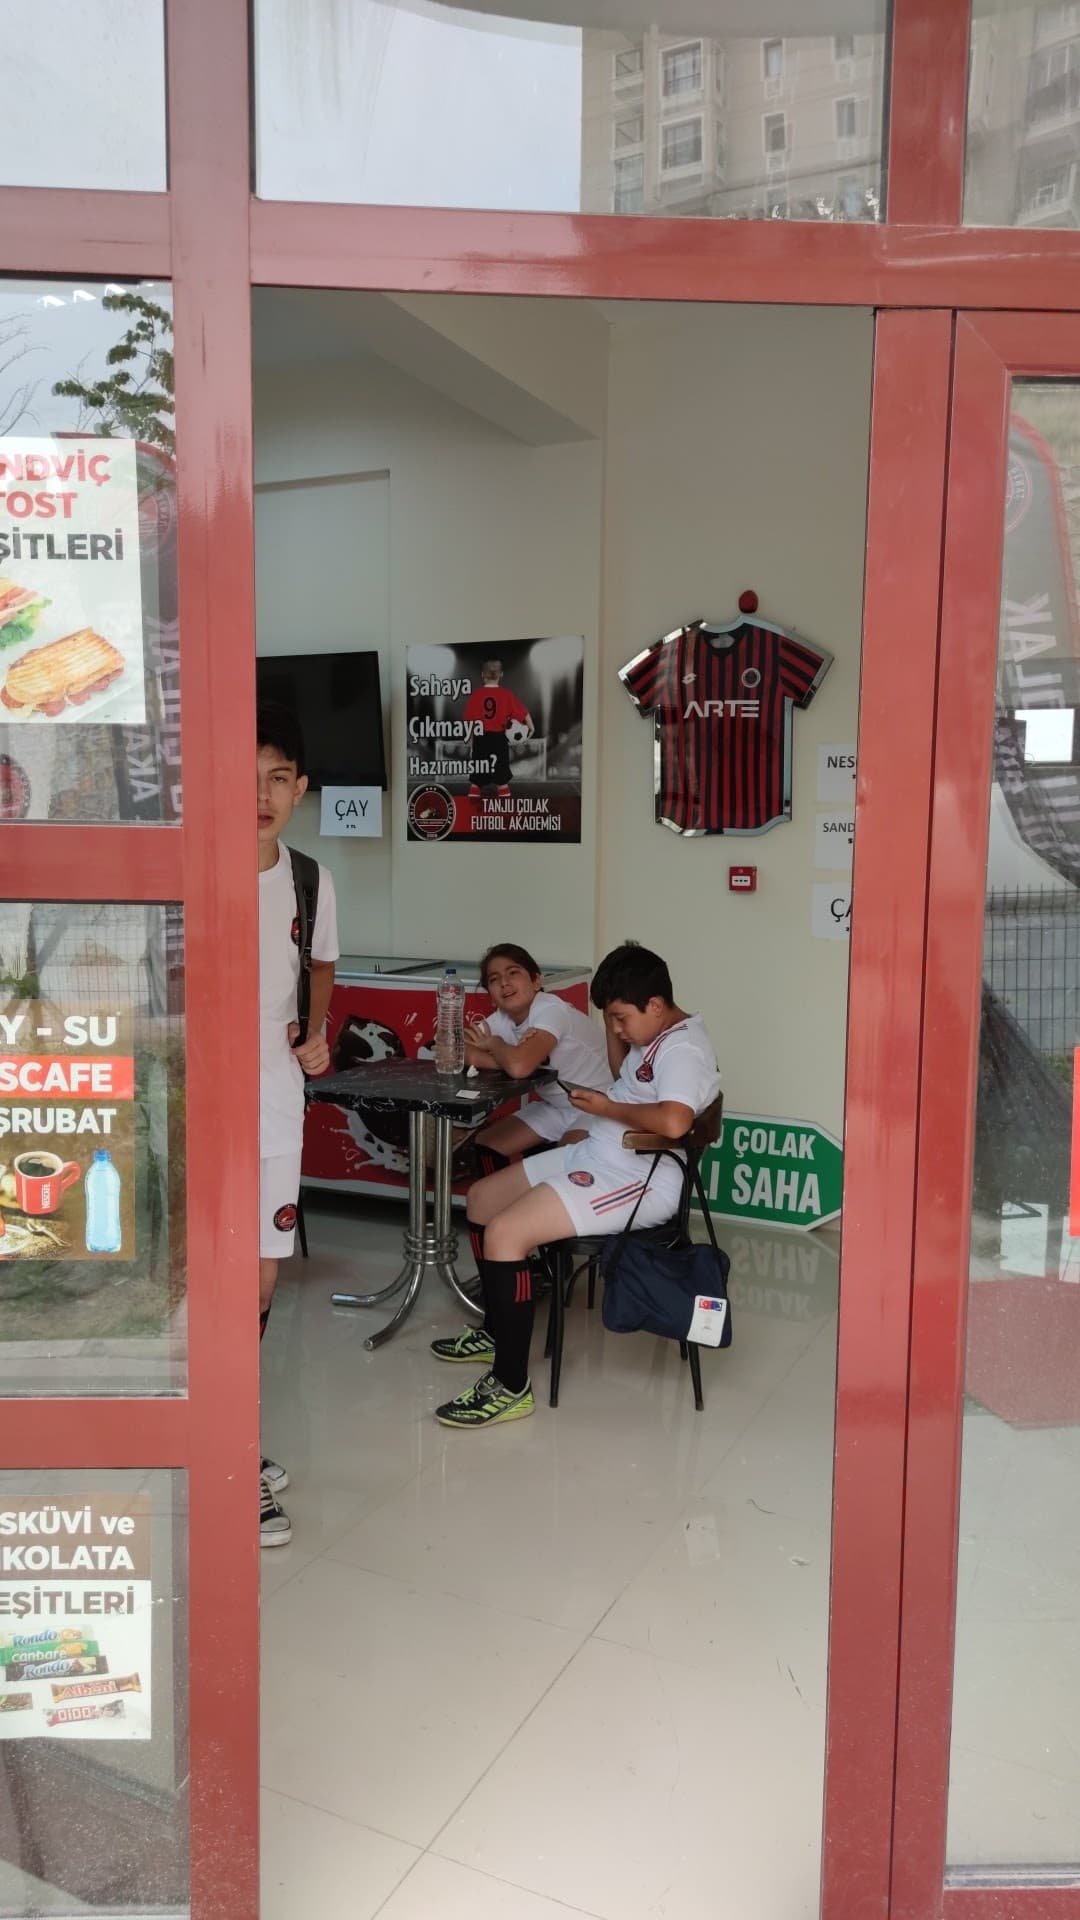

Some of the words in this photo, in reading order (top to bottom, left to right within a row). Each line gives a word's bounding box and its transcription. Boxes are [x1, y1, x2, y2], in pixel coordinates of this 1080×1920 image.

[409, 674, 472, 700] Sahaya
[483, 696, 497, 720] 9
[683, 700, 760, 719] ARTE
[409, 716, 484, 743] Çıkmaya
[409, 754, 497, 776] Hazırmısın?
[827, 755, 858, 769] NES
[335, 799, 369, 821] ÇAY
[482, 798, 514, 813] TANJU
[516, 798, 549, 816] ÇOLAK
[471, 815, 507, 830] FUTBOL
[509, 814, 561, 831] AKADEMİSİ
[63, 1015, 117, 1047] SU
[733, 1126, 817, 1161] ÇOLAK
[731, 1163, 822, 1216] SAHA
[100, 1515, 135, 1536] ve
[3, 1545, 135, 1571] KOLATA
[12, 1629, 58, 1647] Rondo
[24, 1659, 71, 1679] Rondo
